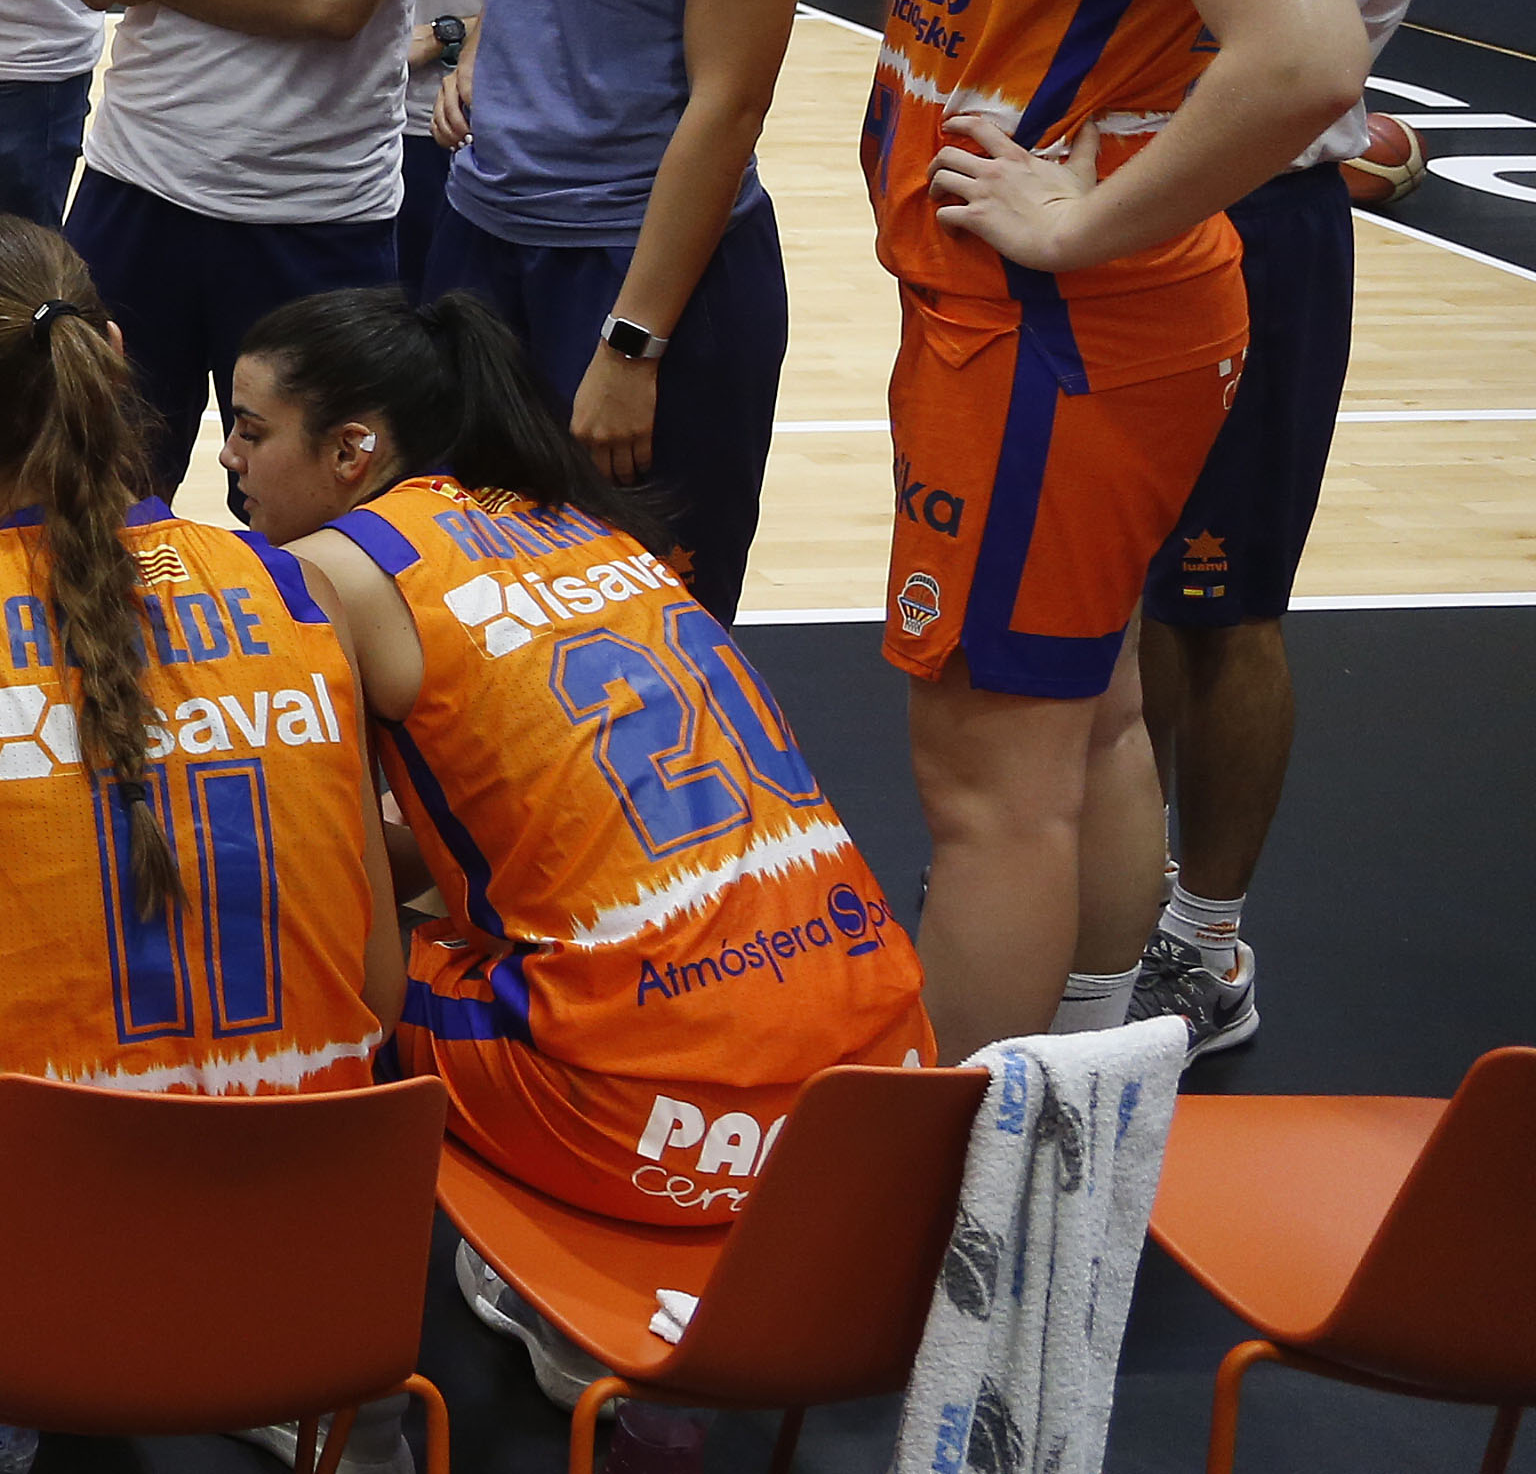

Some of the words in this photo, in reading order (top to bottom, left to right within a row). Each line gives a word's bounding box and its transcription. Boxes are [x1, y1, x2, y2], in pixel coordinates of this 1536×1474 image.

[1182, 559, 1230, 572] luanvi
[3, 587, 272, 670] ALDE
[142, 672, 341, 761] saval
[547, 600, 828, 863] 20
[89, 757, 284, 1046] 11
